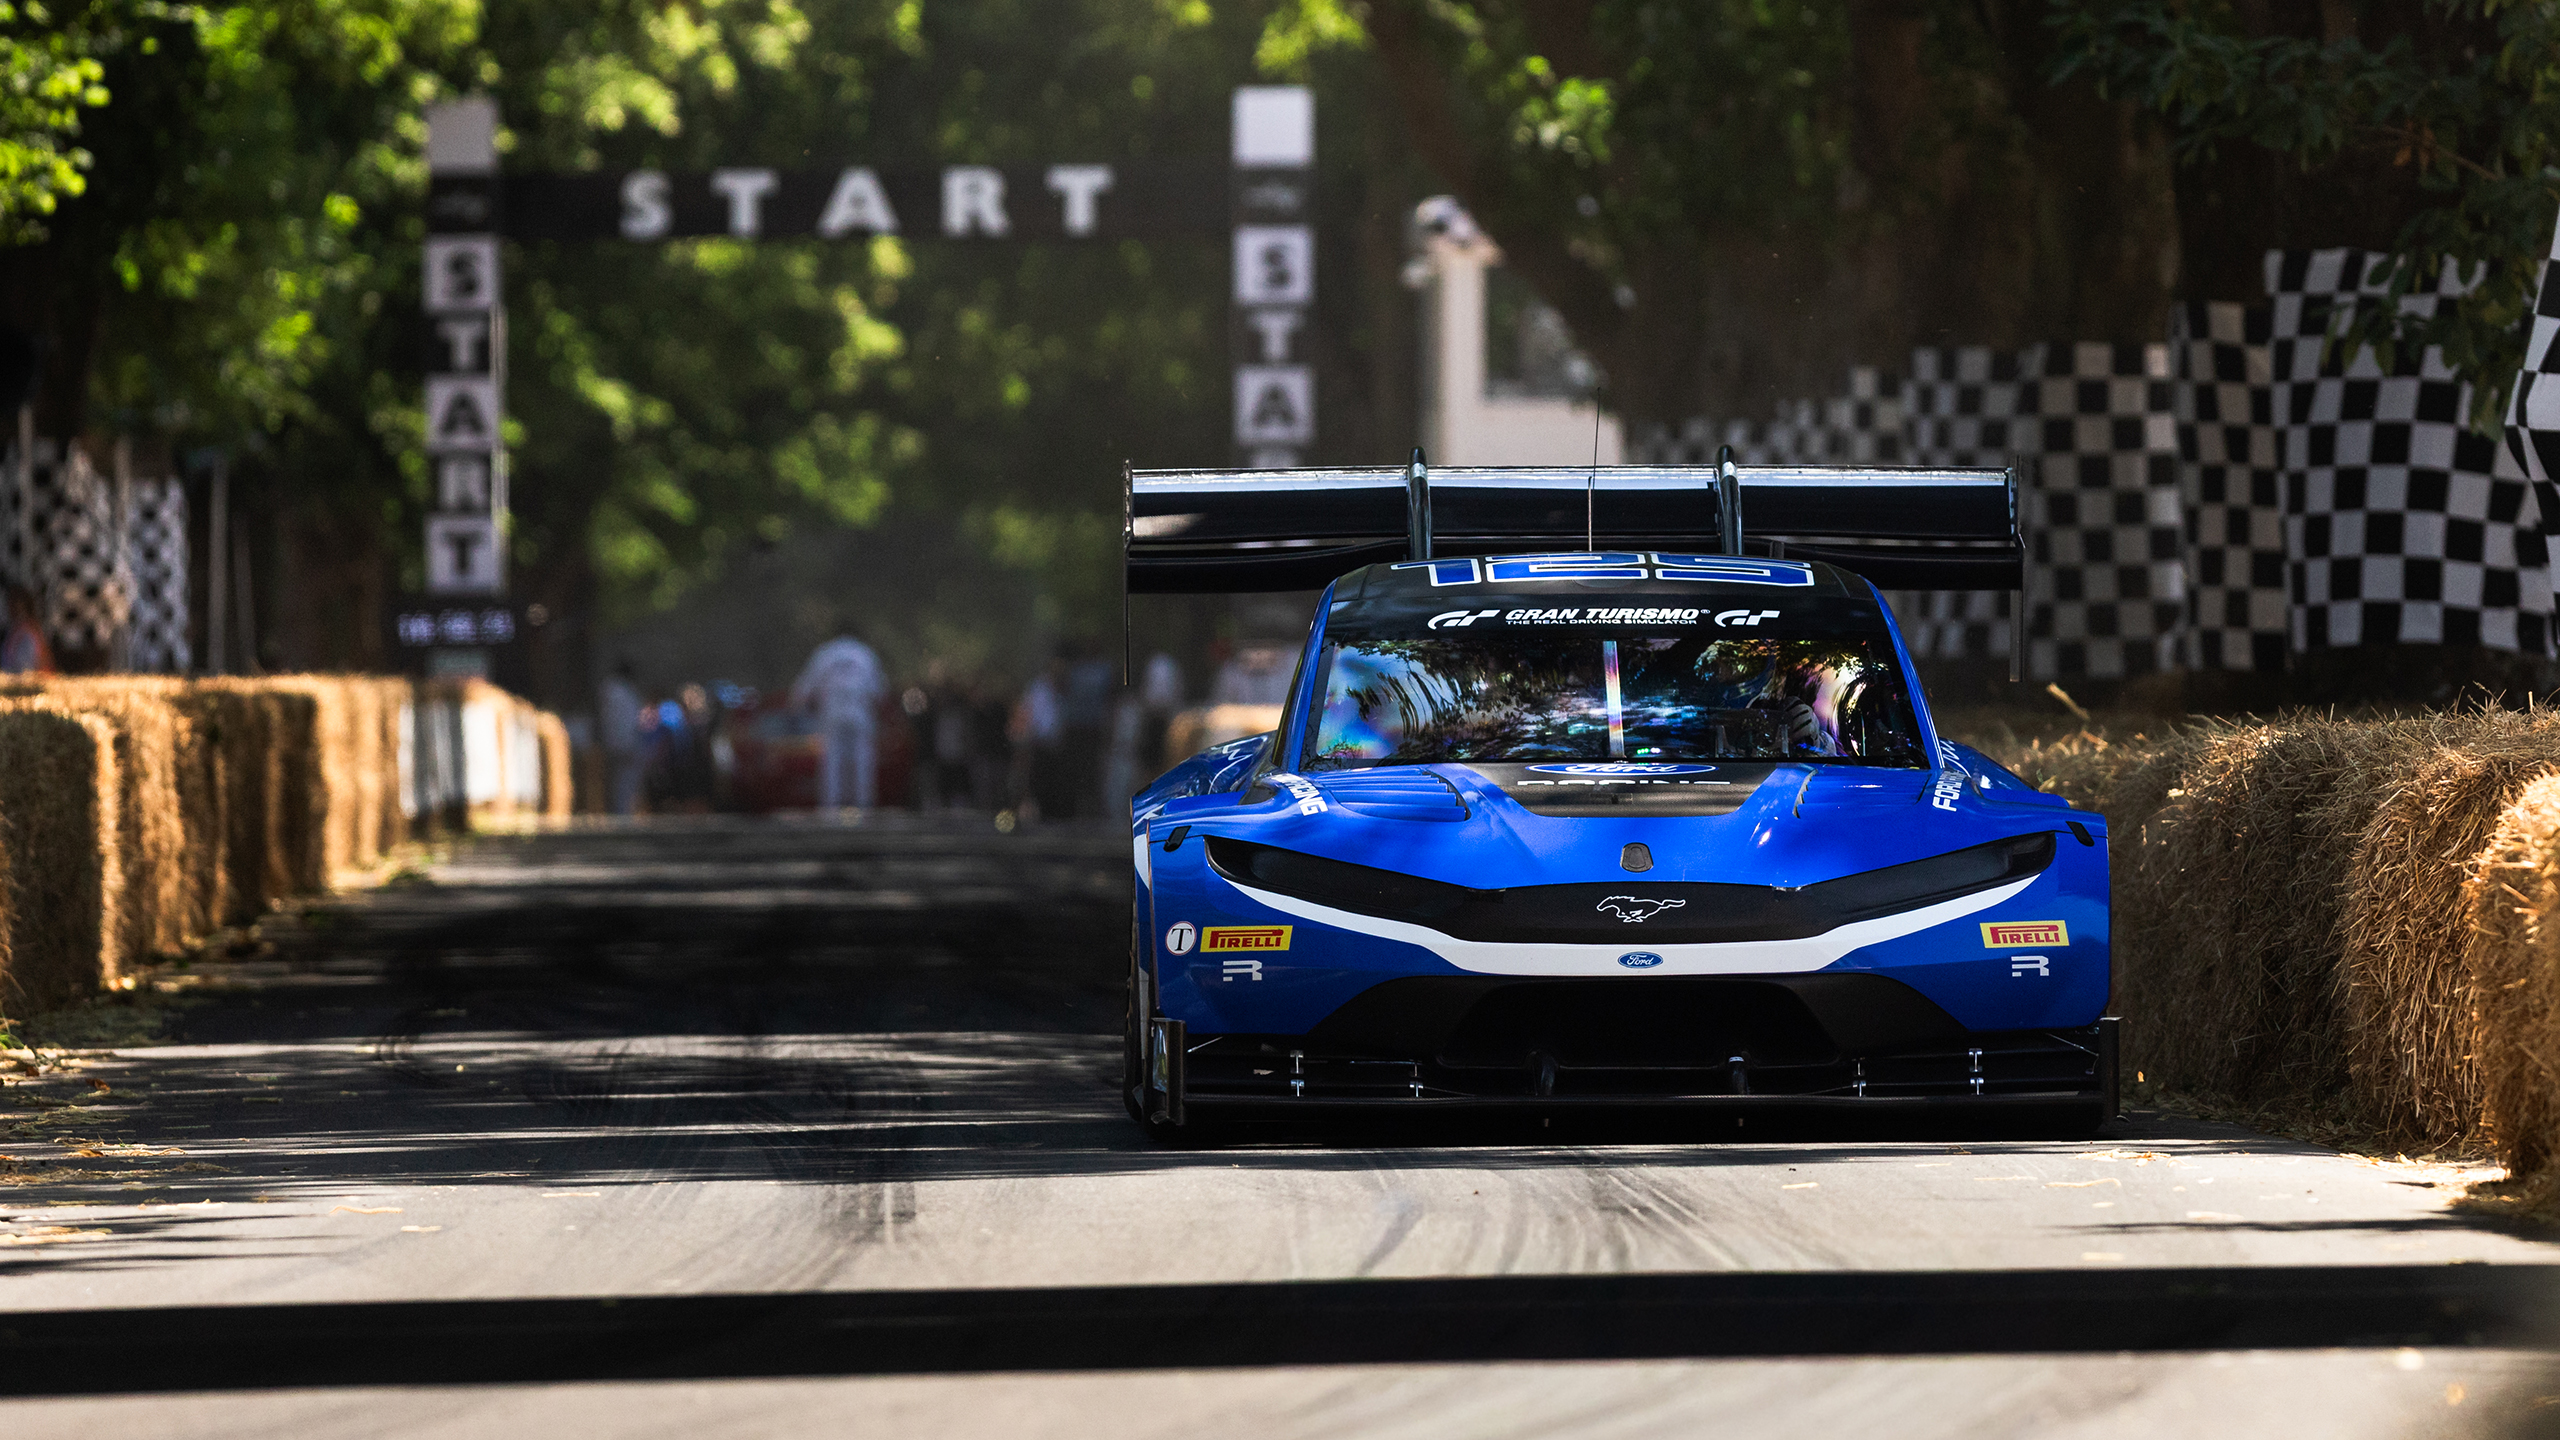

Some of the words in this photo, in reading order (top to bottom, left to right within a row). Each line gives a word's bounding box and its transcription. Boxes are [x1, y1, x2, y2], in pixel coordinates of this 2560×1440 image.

[620, 165, 1112, 239] START
[438, 252, 488, 577] START
[1390, 552, 1815, 587] 125
[1505, 608, 1580, 620] GRAN
[1209, 929, 1284, 948] PIRELLI
[1989, 925, 2060, 944] PIRELLI
[1626, 954, 1655, 965] Ford
